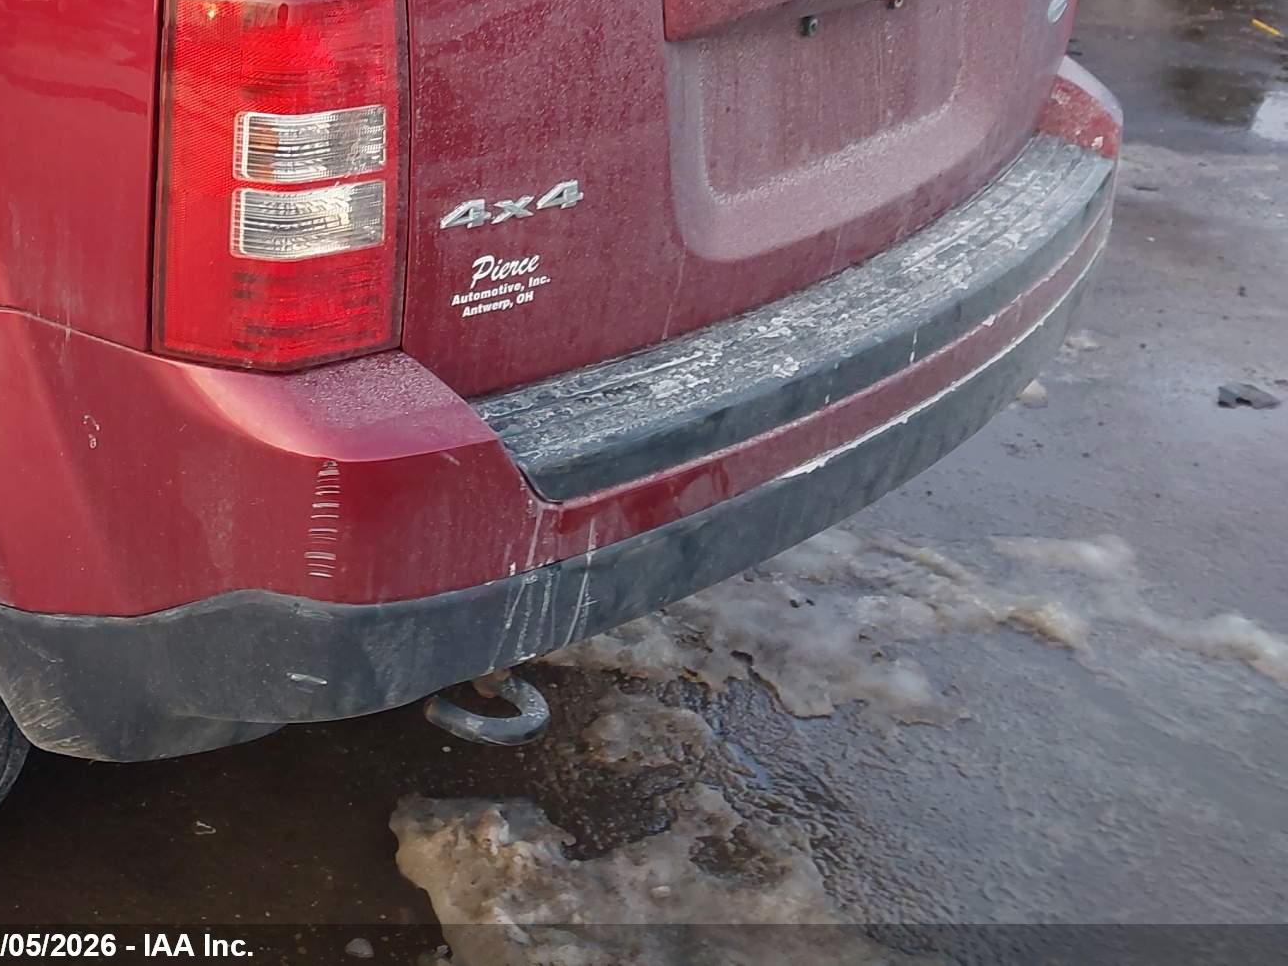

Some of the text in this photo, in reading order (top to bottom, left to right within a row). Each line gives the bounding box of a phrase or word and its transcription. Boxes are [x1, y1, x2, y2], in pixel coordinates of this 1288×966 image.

[470, 254, 540, 289] Pierce
[451, 275, 551, 306] Automotive, Inc.
[462, 290, 534, 317] Antwerp, OH
